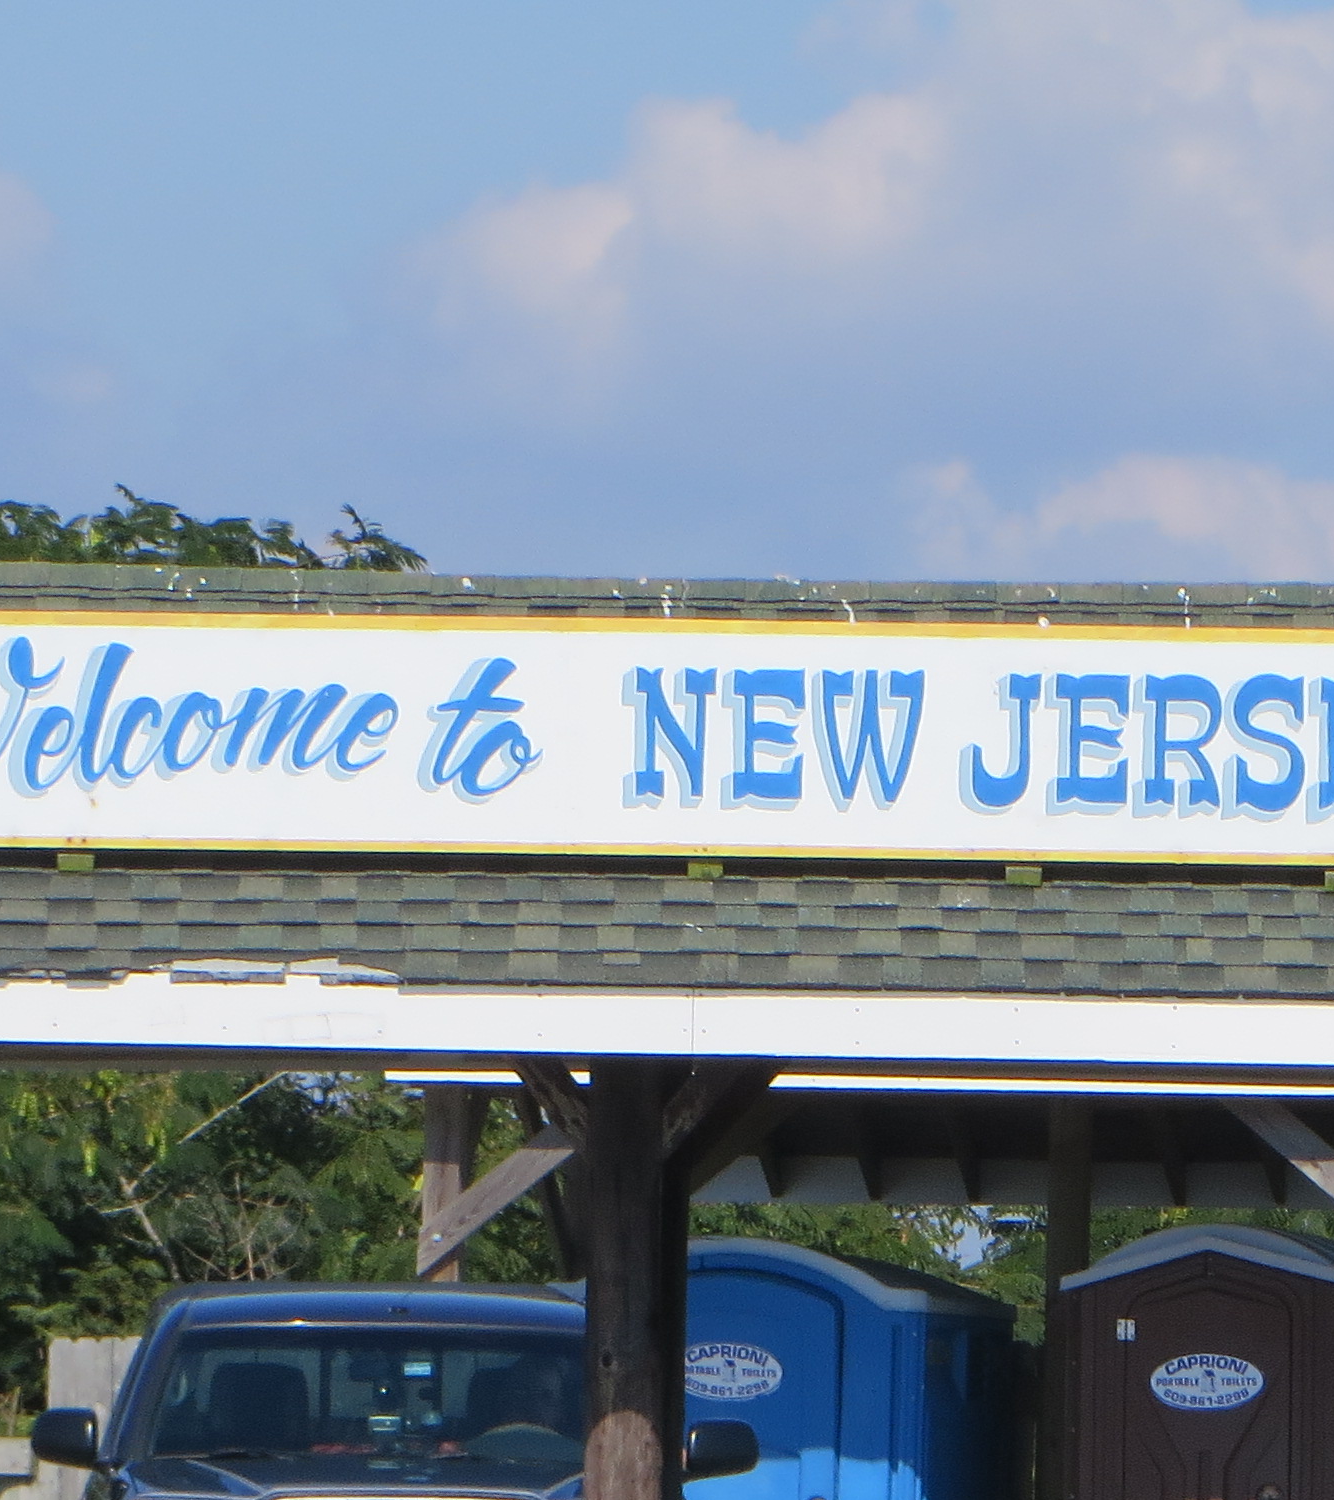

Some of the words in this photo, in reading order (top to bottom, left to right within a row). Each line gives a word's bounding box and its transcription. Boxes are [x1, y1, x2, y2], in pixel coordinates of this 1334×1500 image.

[417, 657, 543, 804] to
[621, 667, 925, 813] NEW
[687, 1345, 768, 1366] CAPRIONI
[1165, 1355, 1248, 1375] CAPRIONI
[1156, 1377, 1199, 1387] PORTABLE
[1221, 1377, 1258, 1387] TOILETS
